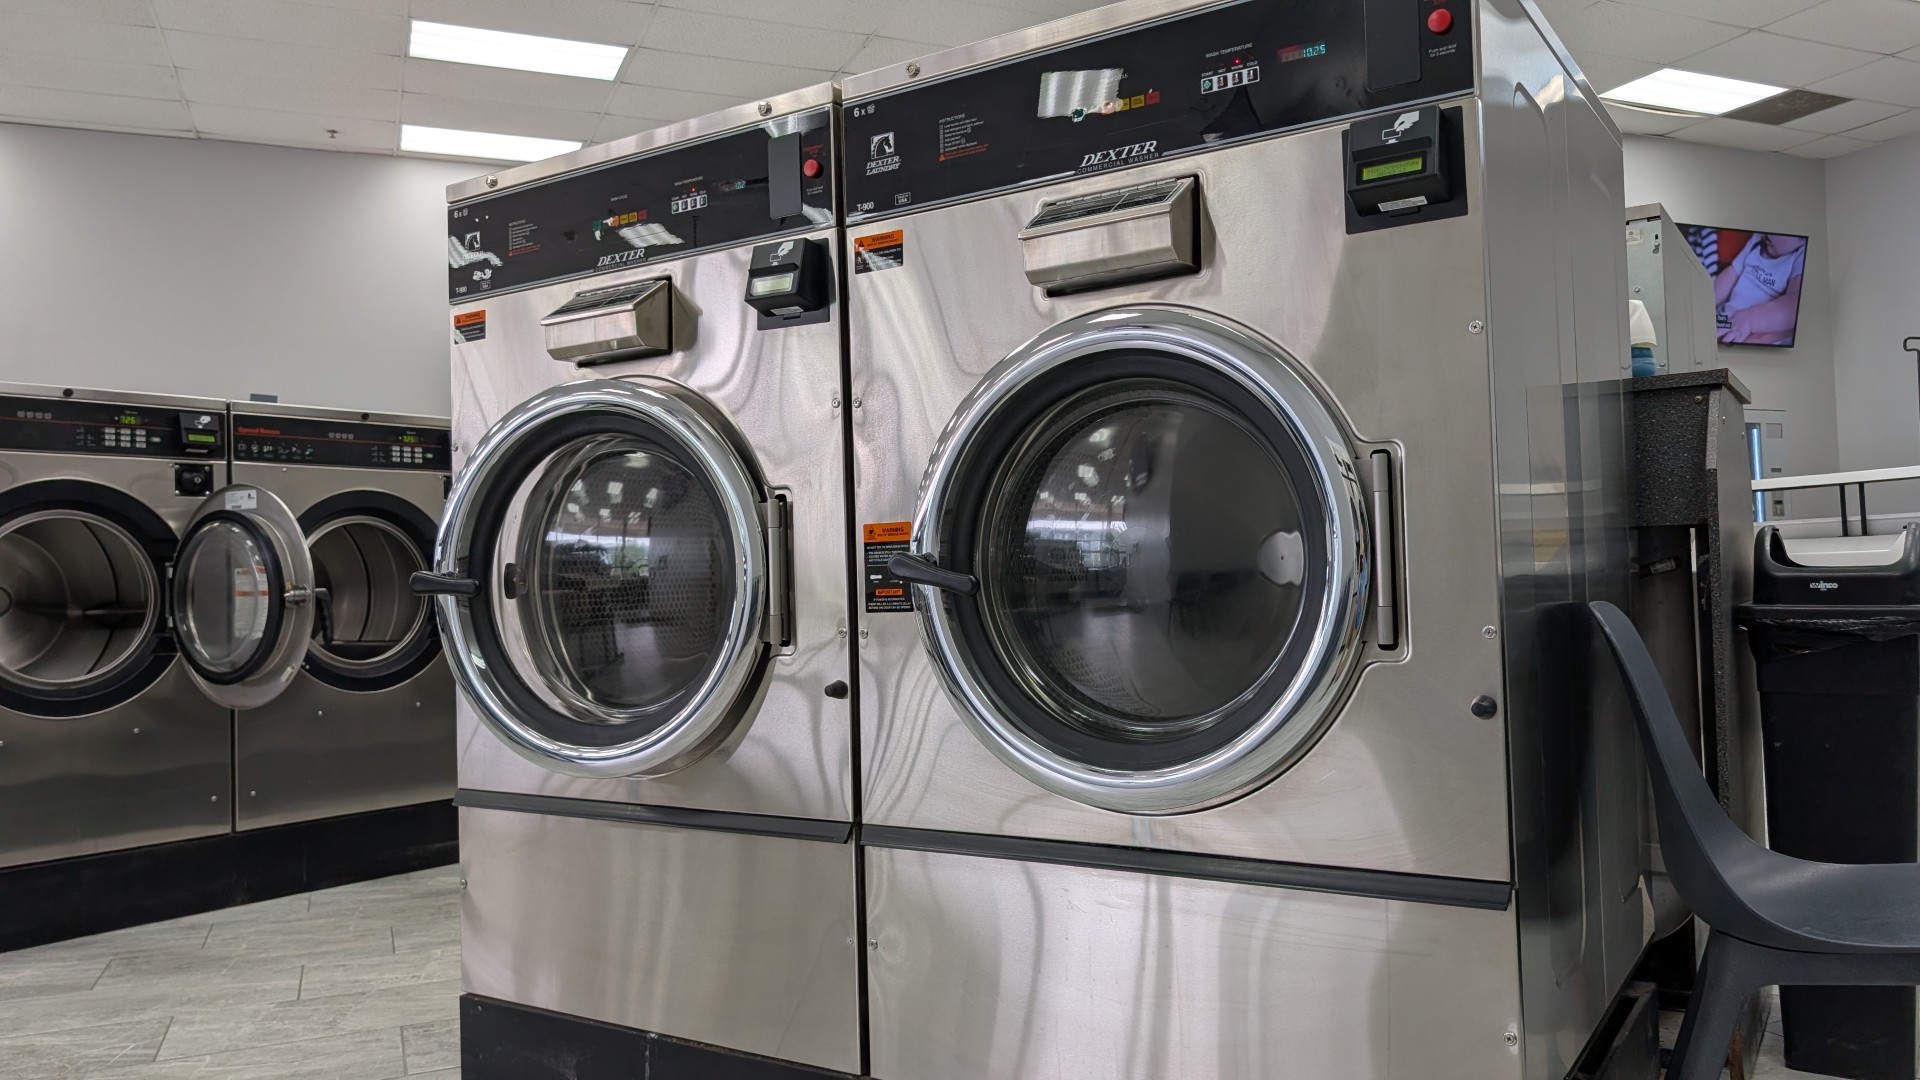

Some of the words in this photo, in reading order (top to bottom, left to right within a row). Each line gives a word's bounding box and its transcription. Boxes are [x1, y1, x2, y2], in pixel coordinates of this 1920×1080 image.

[853, 107, 860, 118] 6
[1079, 140, 1158, 168] DEXTER
[865, 162, 901, 176] LAUNDRY
[866, 156, 900, 170] DEXTER
[1077, 159, 1125, 175] COMMERCIAL
[1128, 151, 1160, 164] WASHER
[856, 201, 875, 212] T-900
[596, 248, 645, 267] DEXTER
